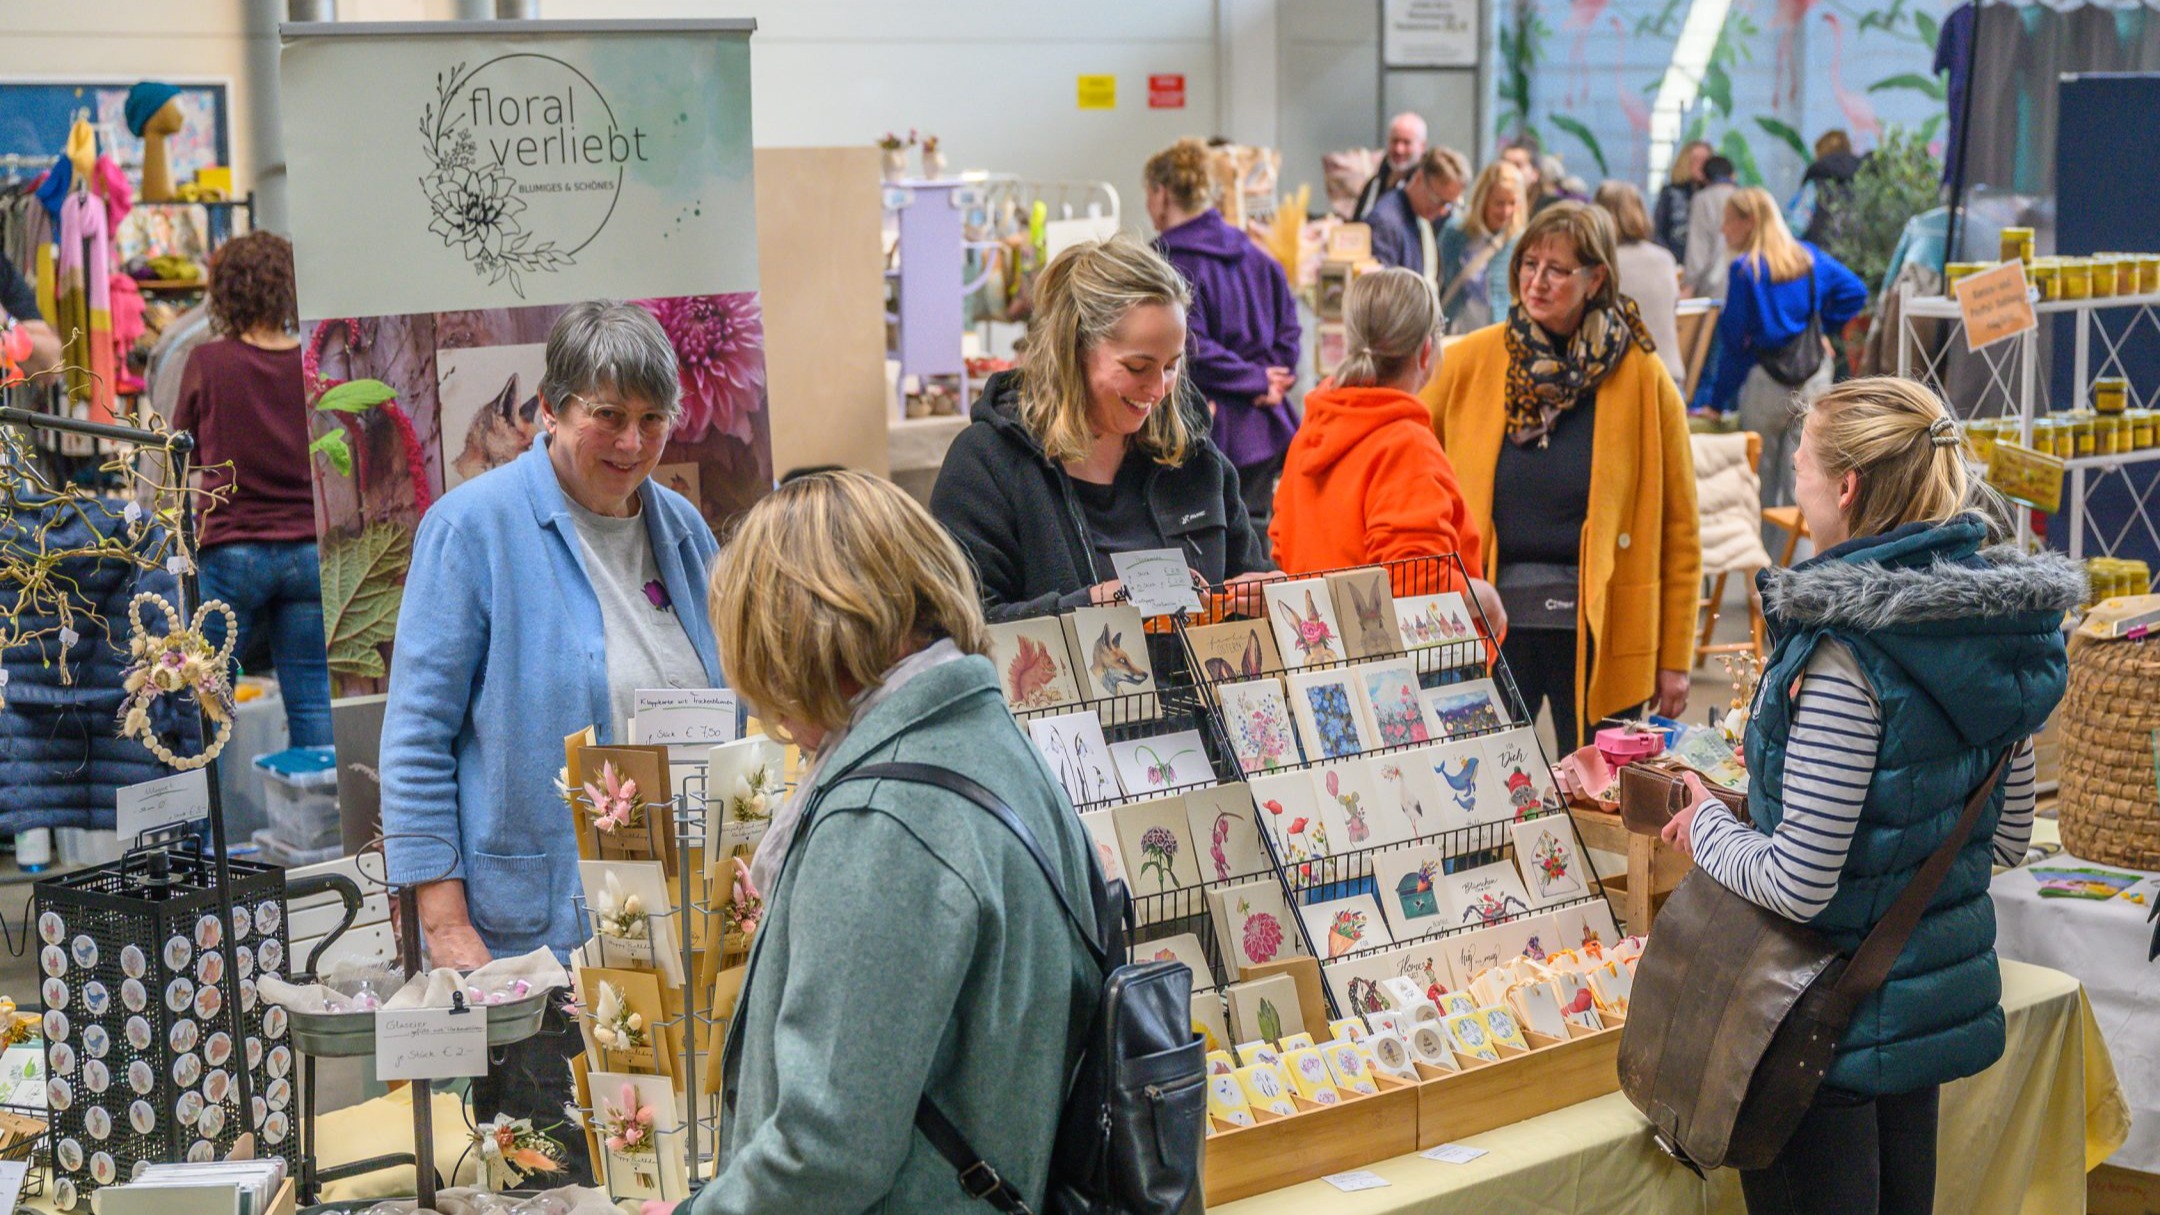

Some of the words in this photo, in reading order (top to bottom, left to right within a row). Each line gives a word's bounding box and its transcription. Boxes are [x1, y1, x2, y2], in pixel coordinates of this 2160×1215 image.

[469, 86, 574, 126] floral
[490, 125, 648, 167] verliebt
[518, 182, 563, 194] BLUMIGES
[565, 183, 572, 193] &
[574, 180, 615, 192] SCHÖNES
[700, 725, 721, 739] 7,50
[408, 1048, 434, 1060] Stück
